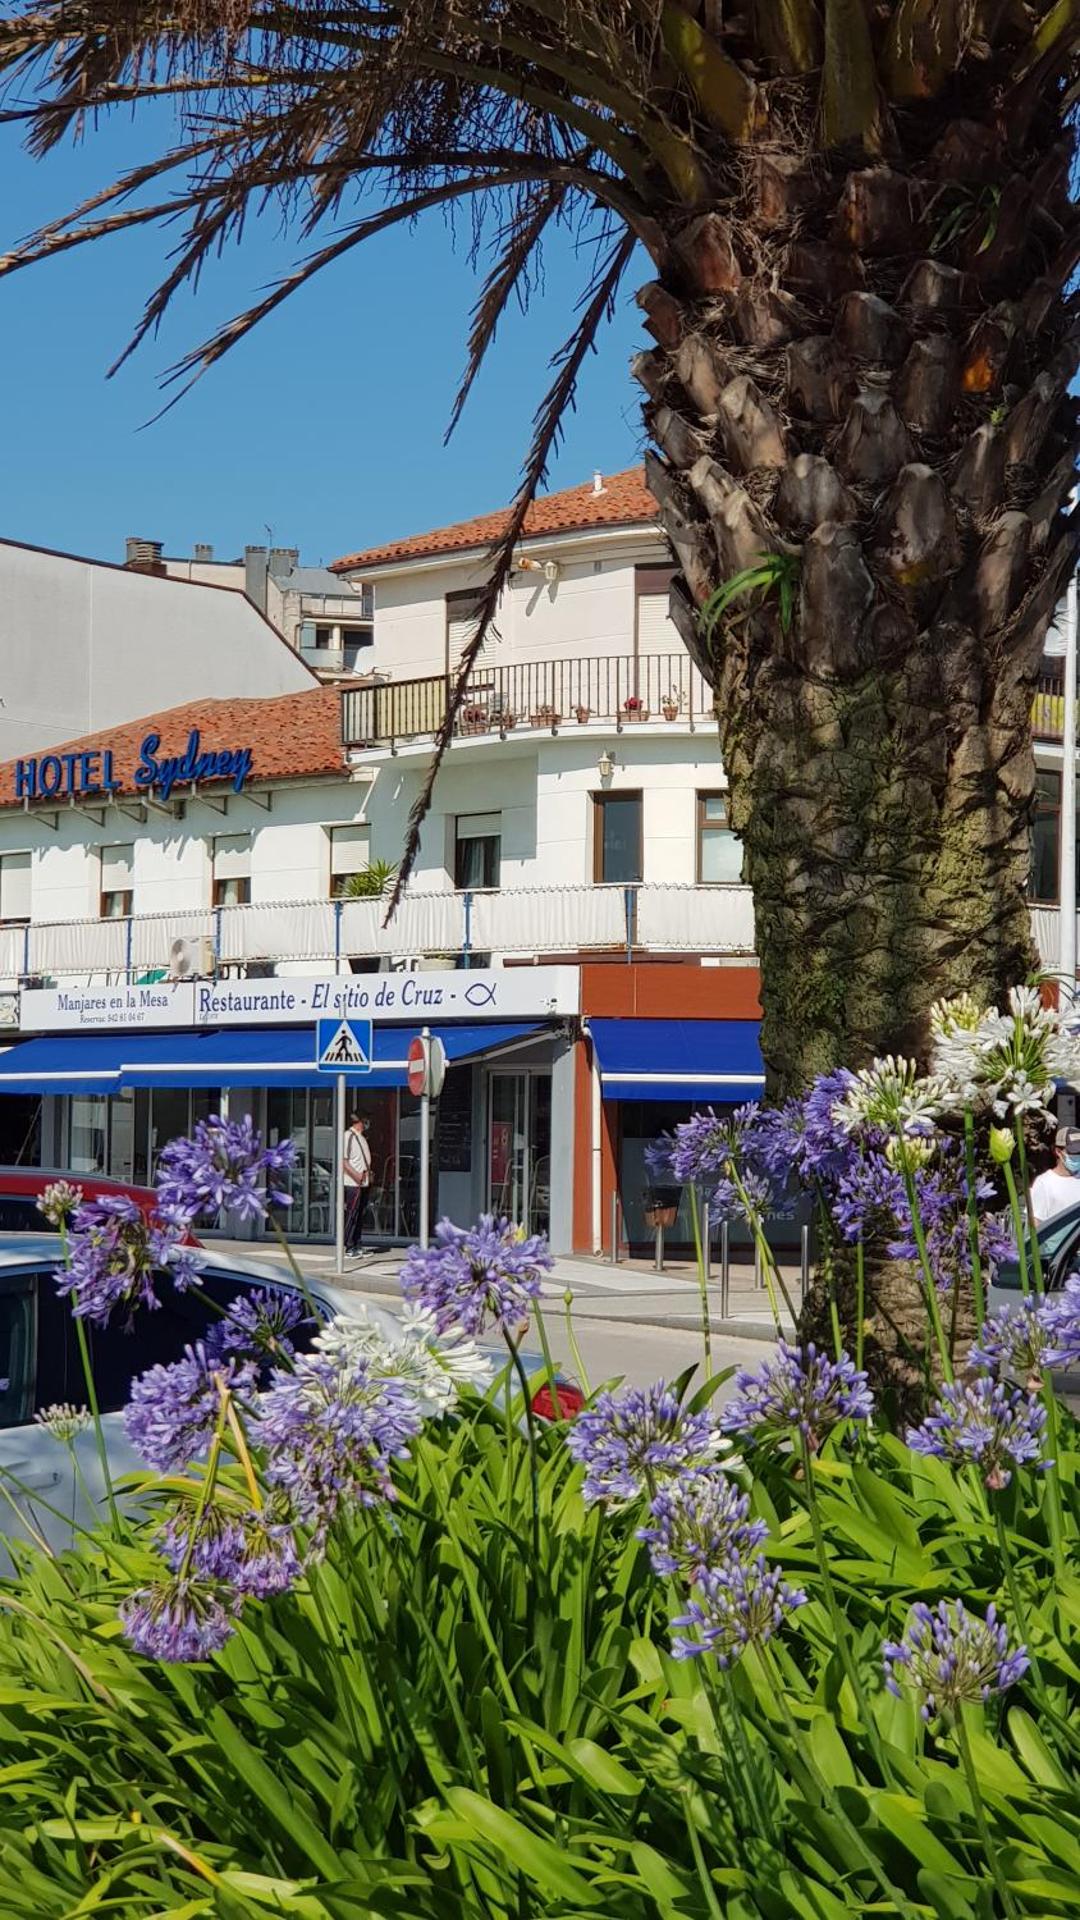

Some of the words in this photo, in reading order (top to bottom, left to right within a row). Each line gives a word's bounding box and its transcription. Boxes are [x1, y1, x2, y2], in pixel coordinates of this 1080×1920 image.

[16, 750, 122, 797] HOTEL
[134, 728, 253, 801] Sydney
[58, 994, 106, 1013] Manjares
[110, 999, 123, 1009] en
[126, 990, 136, 1008] la
[140, 990, 168, 1008] Mesa
[199, 987, 295, 1012] Restaurante
[311, 983, 330, 1008] El
[334, 984, 369, 1008] sitio
[375, 981, 395, 1007] de
[401, 979, 443, 1006] Cruz
